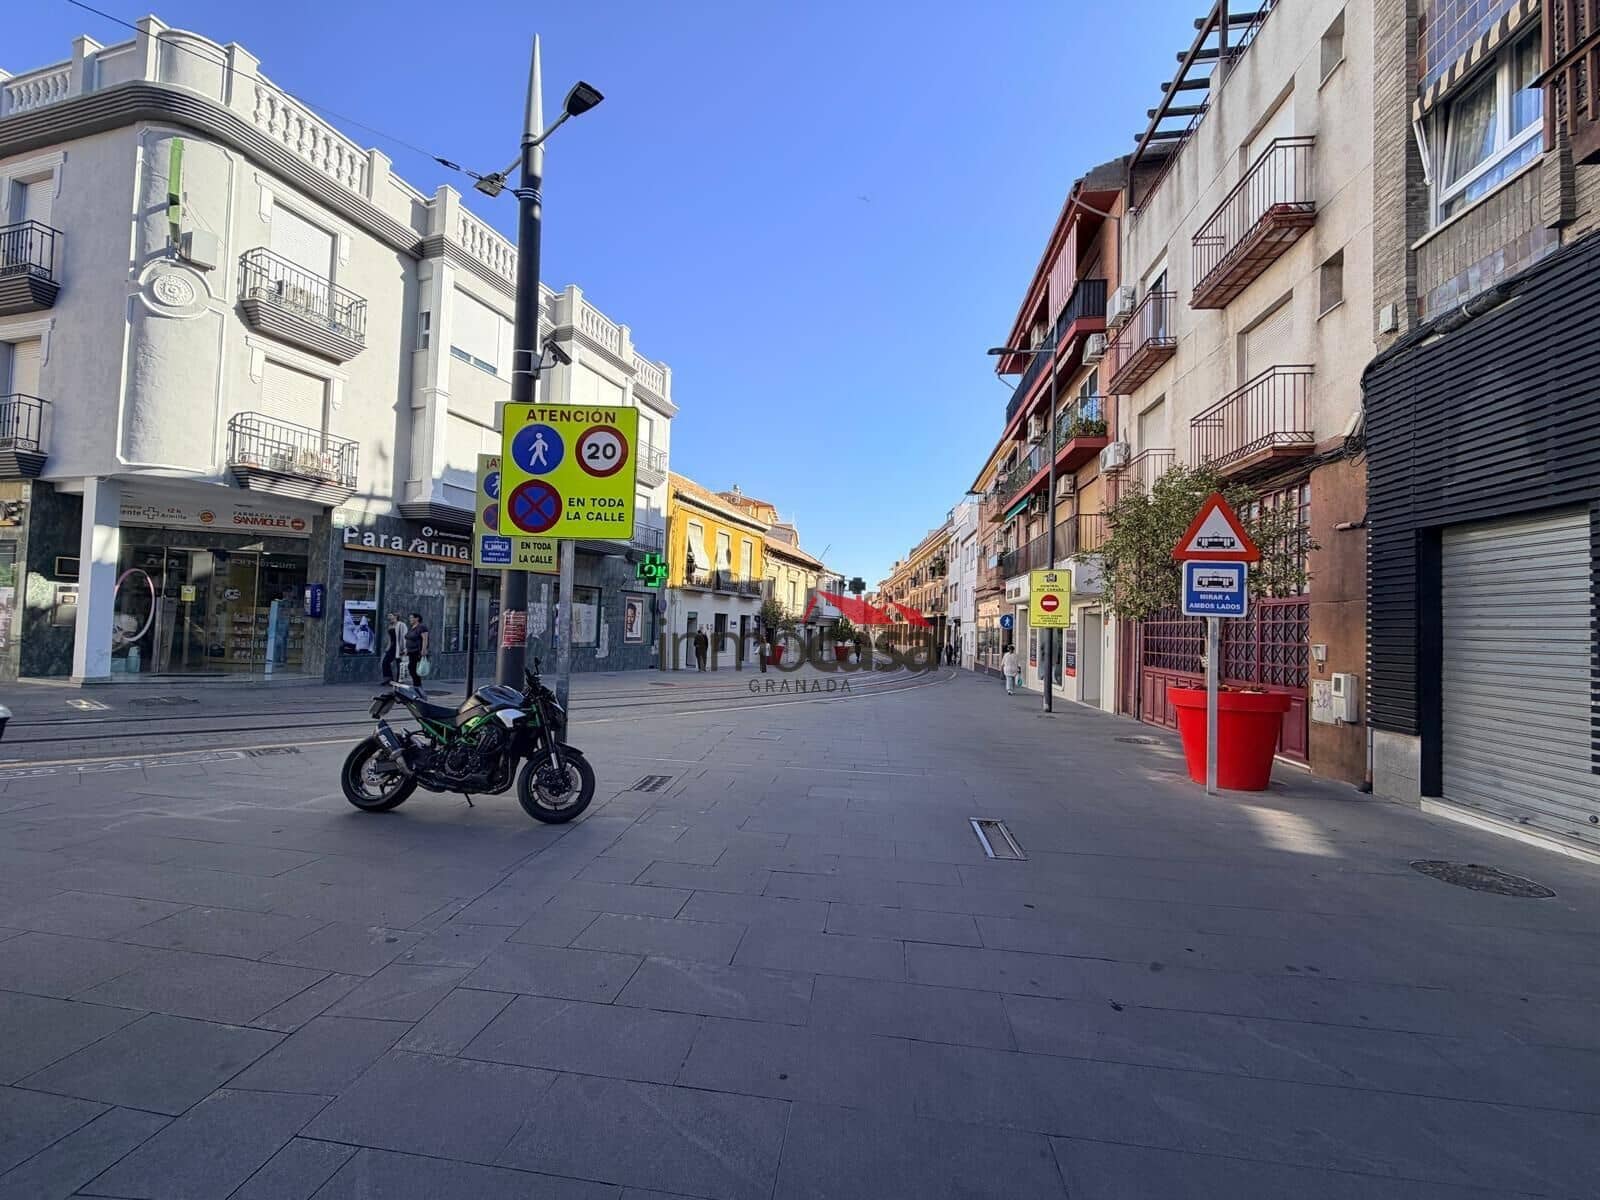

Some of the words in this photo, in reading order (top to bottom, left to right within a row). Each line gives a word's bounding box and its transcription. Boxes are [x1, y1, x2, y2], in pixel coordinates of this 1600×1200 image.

[526, 408, 616, 423] ATENCIÓN
[587, 443, 616, 460] 20
[568, 497, 585, 507] EN
[590, 498, 625, 508] TODA
[566, 512, 581, 520] LA
[586, 512, 625, 522] CALLE
[521, 541, 530, 549] EN
[533, 542, 552, 550] TODA
[519, 555, 529, 563] LA
[530, 555, 553, 564] CALLE
